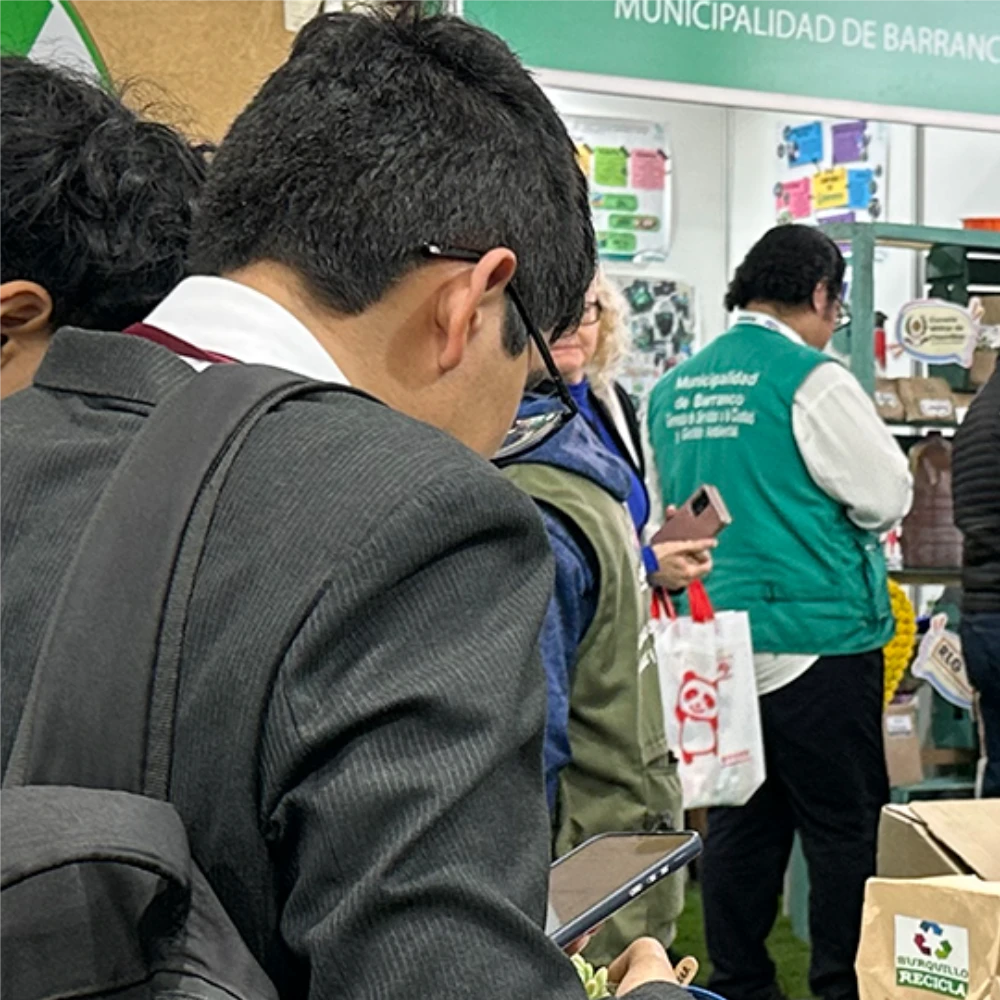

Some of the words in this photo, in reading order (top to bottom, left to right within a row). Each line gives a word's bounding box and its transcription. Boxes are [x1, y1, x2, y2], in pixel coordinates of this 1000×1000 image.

[614, 0, 836, 43] MUNICIPALIDAD
[842, 18, 877, 48] DE
[897, 955, 969, 978] SURQUILLO
[899, 970, 966, 997] RECICLA
